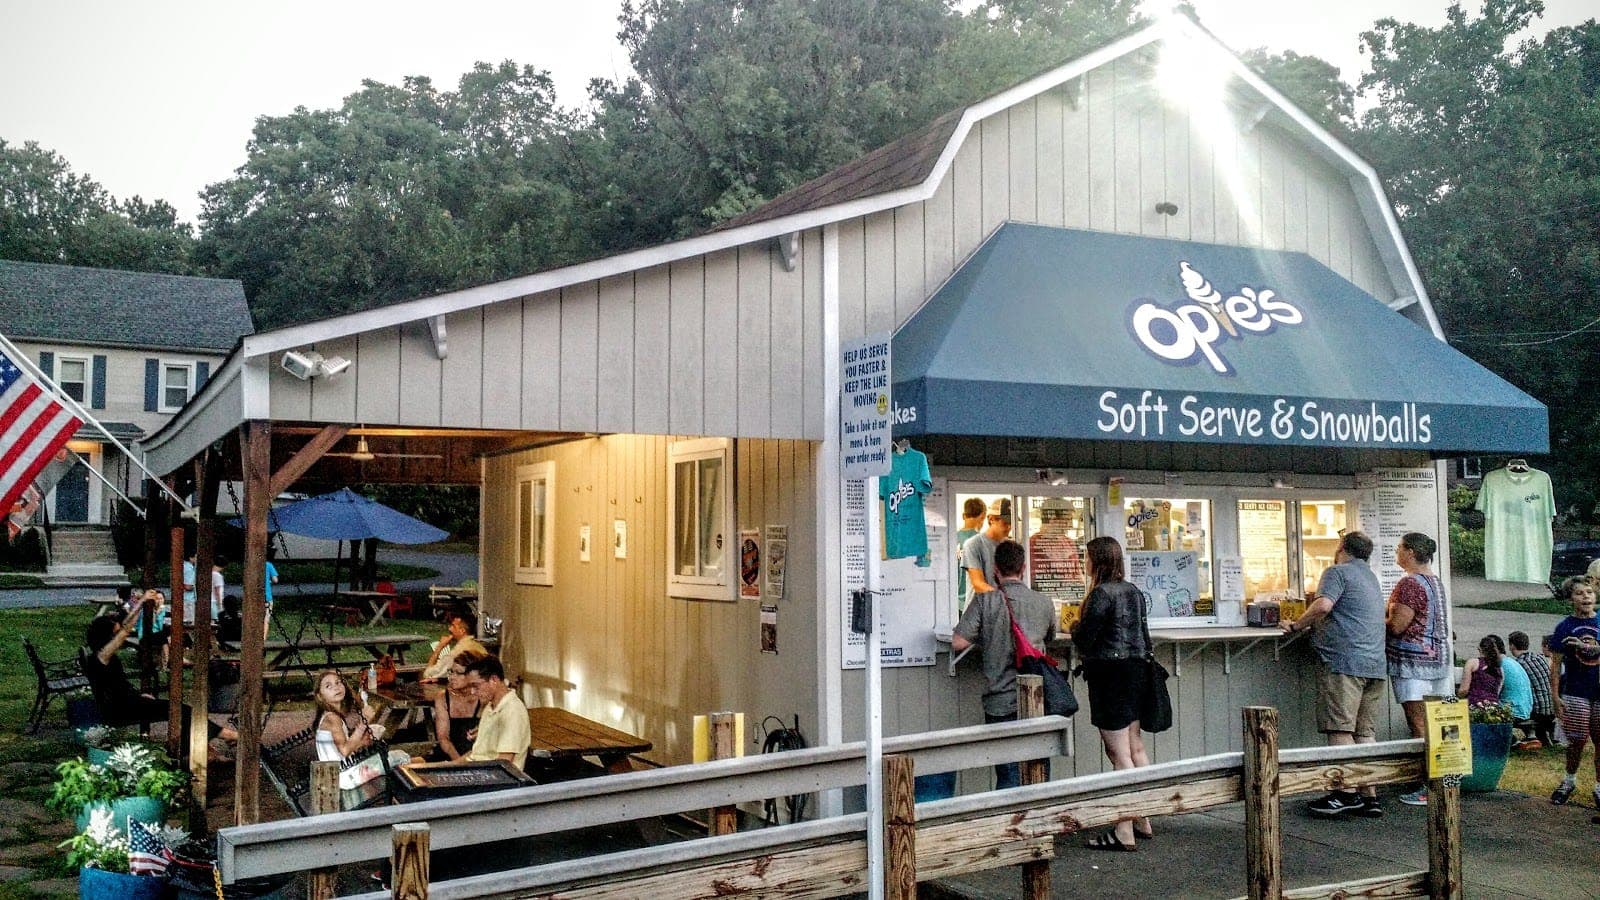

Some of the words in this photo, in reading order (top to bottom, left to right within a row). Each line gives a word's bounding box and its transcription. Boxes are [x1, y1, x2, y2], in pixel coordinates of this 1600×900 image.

[844, 350, 858, 364] HELP
[860, 347, 867, 360] US
[869, 343, 888, 358] SERVE
[846, 365, 857, 378] YOU
[859, 360, 880, 377] FASTER
[881, 359, 886, 371] &
[844, 380, 859, 394] KEEP
[861, 378, 871, 391] THE
[873, 375, 887, 388] LINE
[853, 392, 877, 408] MOVING
[1097, 390, 1168, 437] Soft
[1179, 395, 1263, 438] Serve
[1270, 399, 1295, 440] &
[1300, 401, 1431, 443] Snowballs
[844, 420, 855, 434] Take
[860, 419, 870, 432] look
[872, 419, 878, 431] at
[878, 420, 887, 429] our
[850, 439, 863, 449] menu
[864, 435, 869, 447] &
[869, 434, 881, 446] have
[845, 455, 856, 469] your
[857, 450, 869, 463] order
[870, 447, 886, 464] ready!
